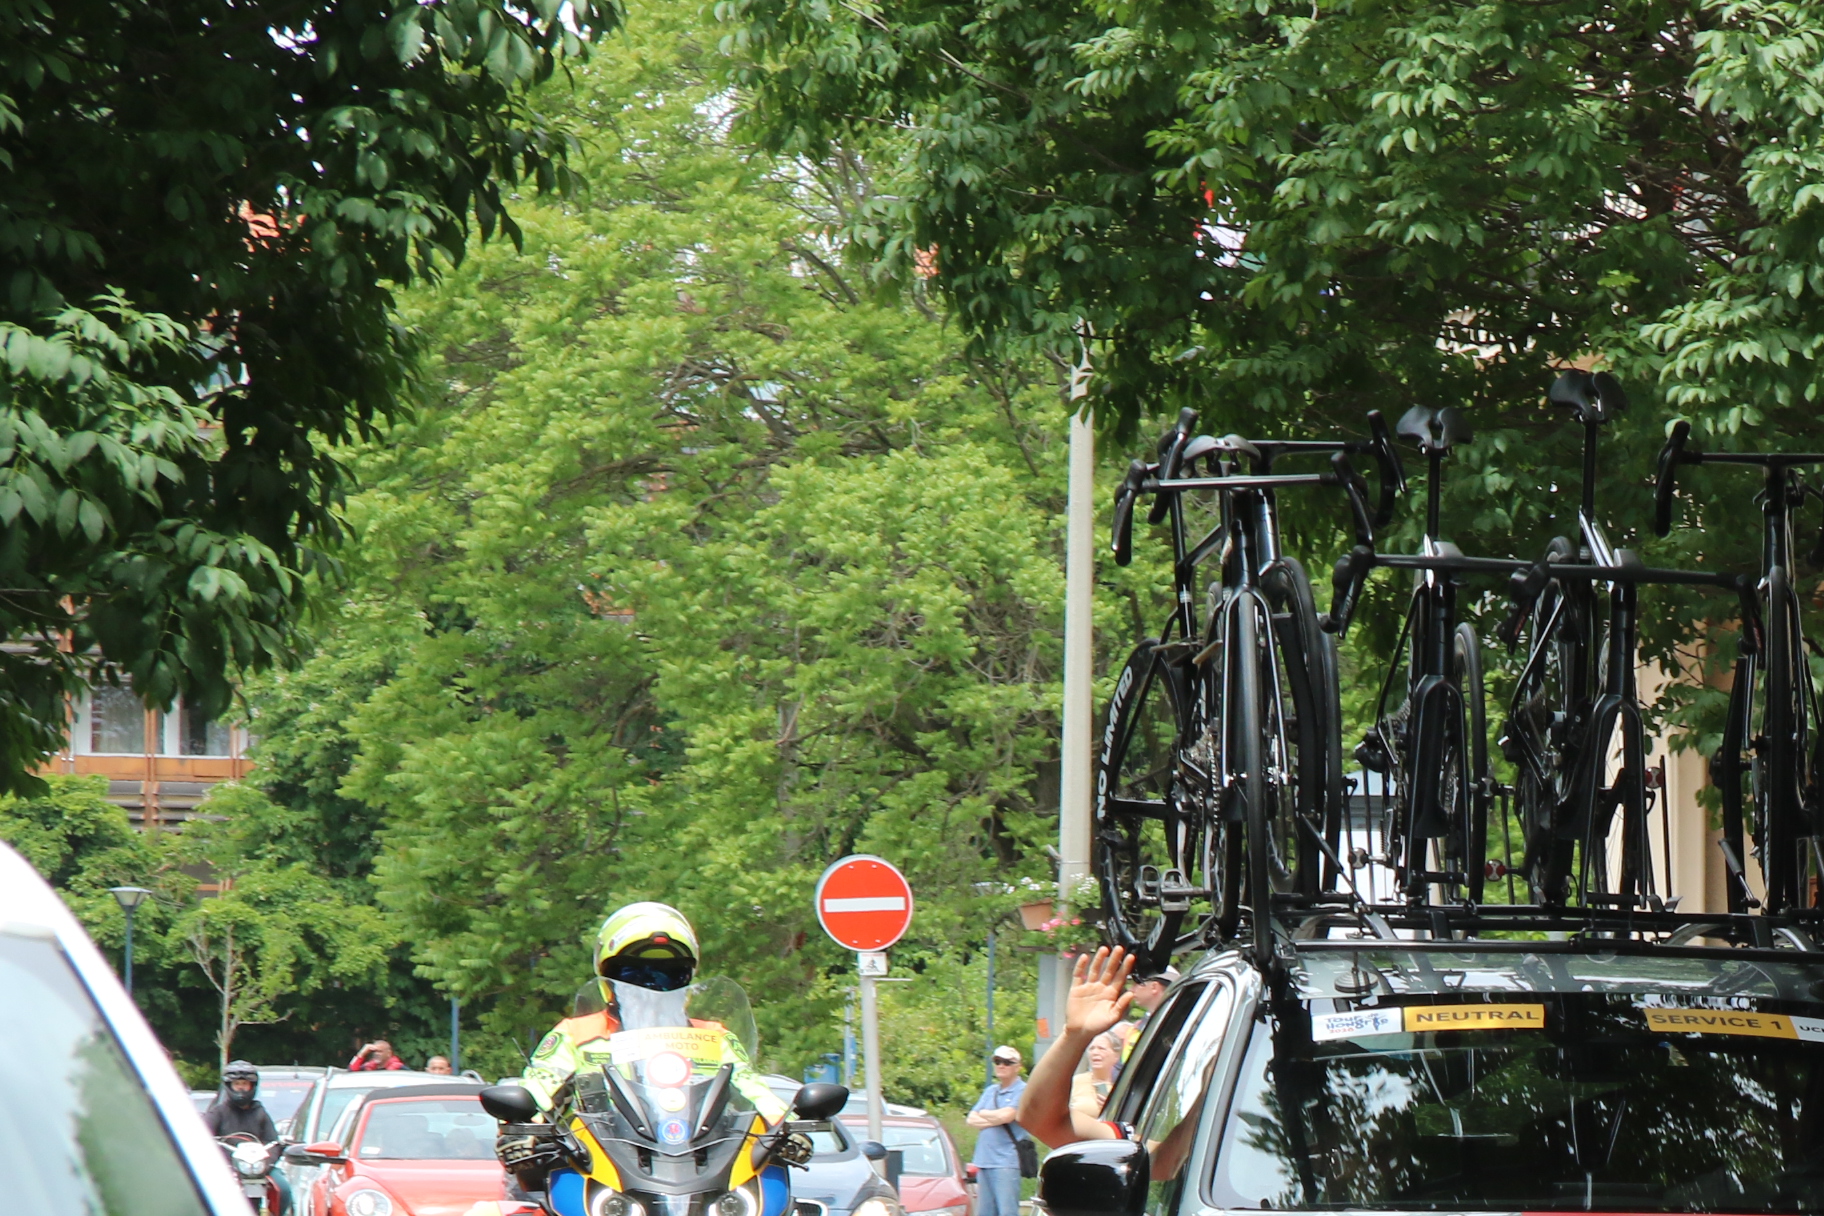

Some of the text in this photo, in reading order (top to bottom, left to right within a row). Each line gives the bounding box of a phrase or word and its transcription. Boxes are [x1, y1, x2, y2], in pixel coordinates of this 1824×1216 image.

[1097, 665, 1133, 819] NO LIMITED
[1416, 1010, 1540, 1023] NEUTRAL
[1651, 1013, 1782, 1031] SERVICE 1
[645, 1032, 718, 1043] AMBULANCE
[665, 1042, 699, 1051] MOTO
